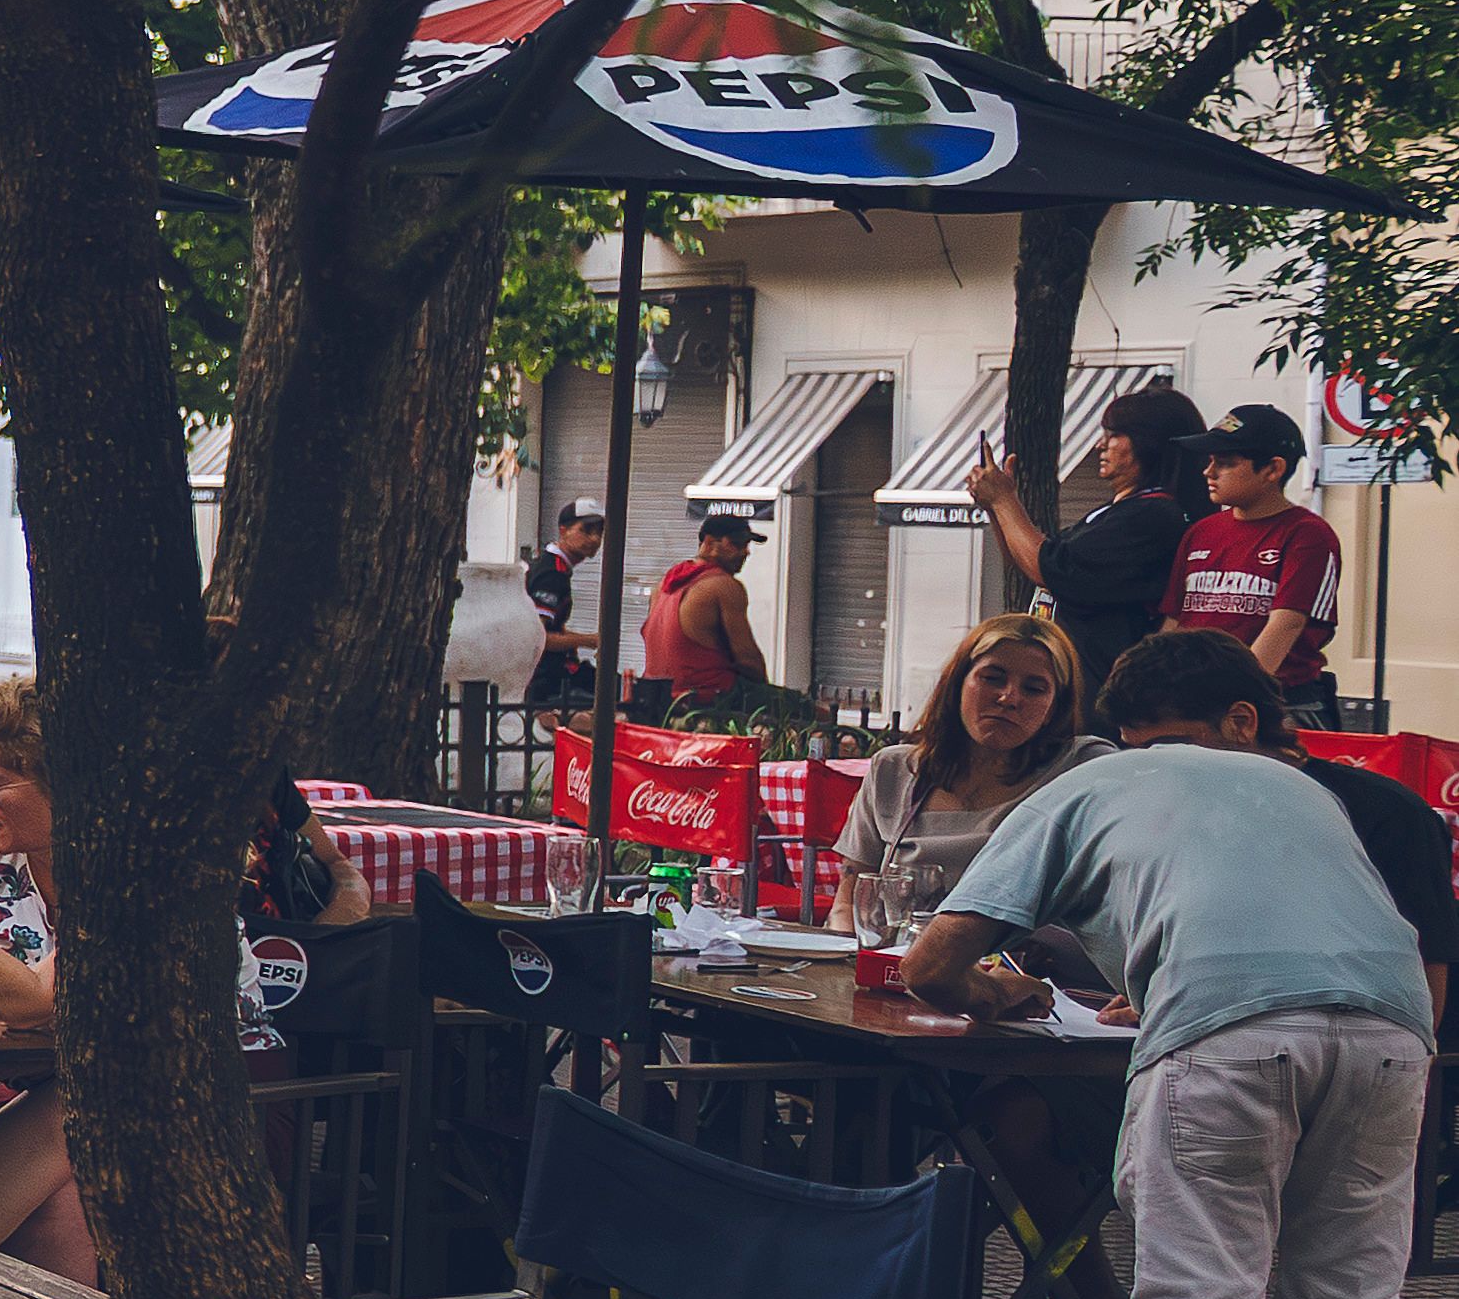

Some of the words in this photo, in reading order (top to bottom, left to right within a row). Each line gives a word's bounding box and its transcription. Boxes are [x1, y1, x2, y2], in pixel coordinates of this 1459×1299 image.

[602, 64, 977, 113] PEPSI
[901, 507, 947, 524] GABRIEL
[948, 507, 969, 524] DEL
[628, 780, 720, 830] Coca-Cola
[258, 962, 304, 985] EPSI
